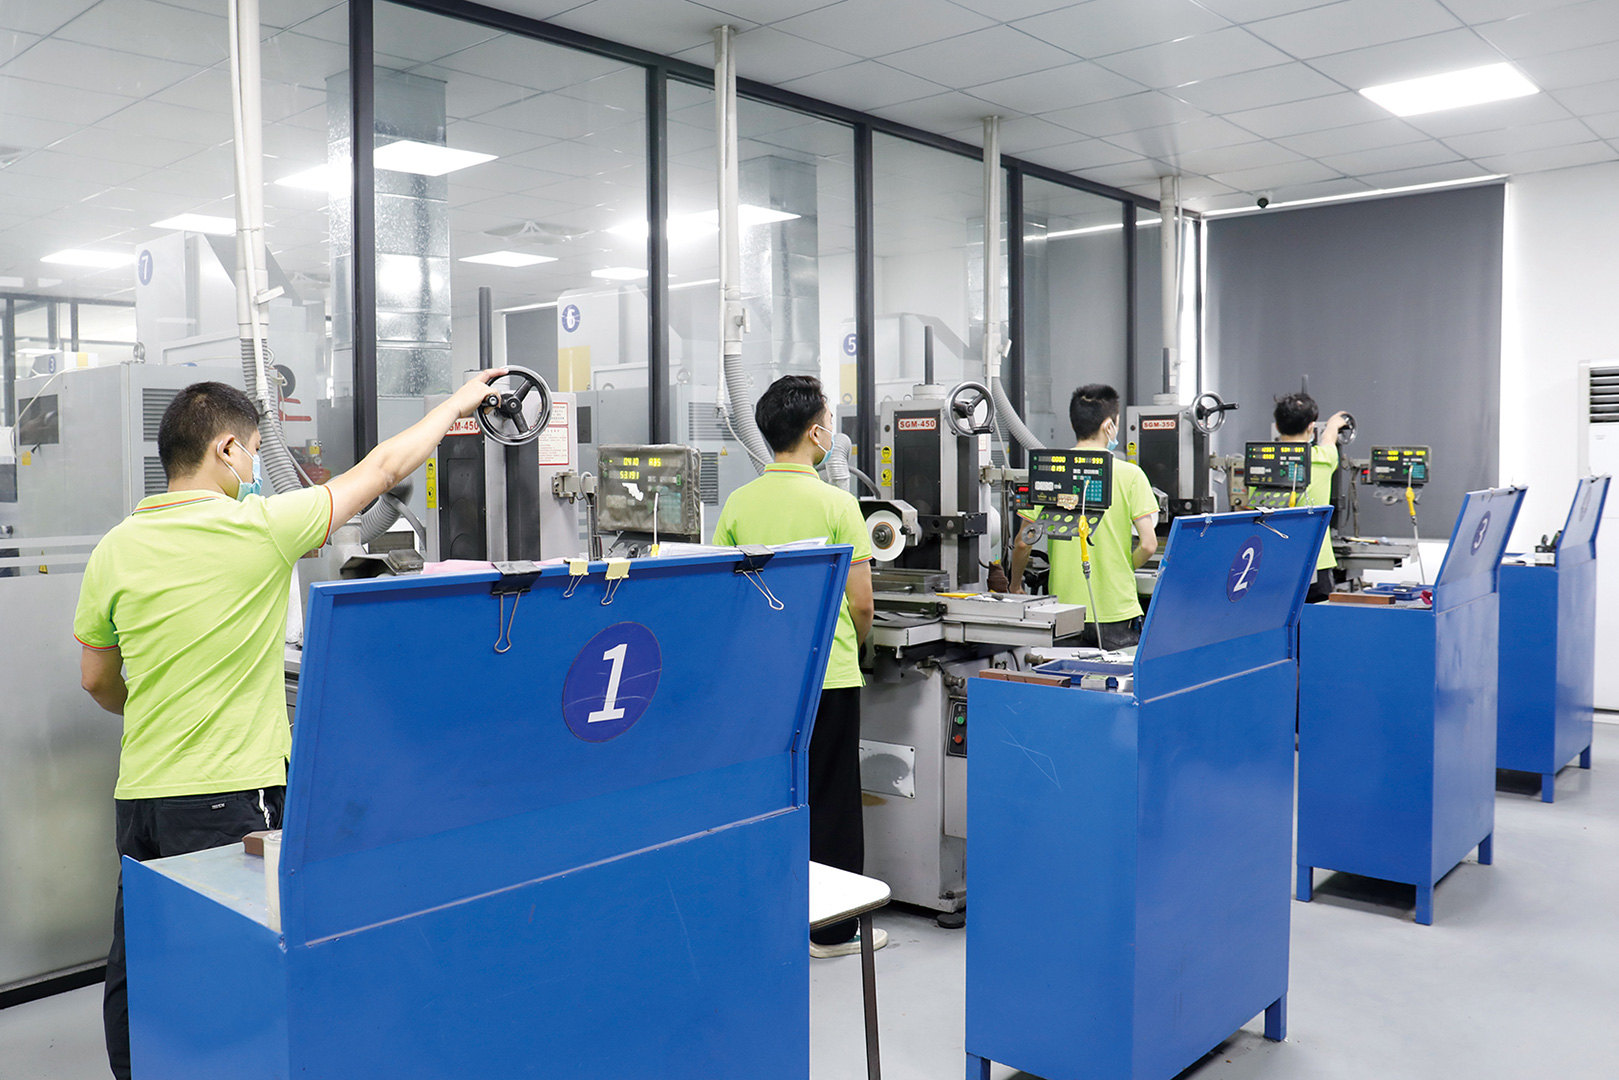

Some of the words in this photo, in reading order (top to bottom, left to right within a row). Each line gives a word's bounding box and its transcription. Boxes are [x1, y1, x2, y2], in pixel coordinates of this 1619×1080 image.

[141, 254, 149, 280] 7
[566, 308, 576, 329] 6
[847, 336, 857, 353] 5
[449, 420, 479, 432] GM-450
[900, 420, 936, 429] SGM-450
[1143, 421, 1176, 429] SGM-350
[1473, 518, 1488, 549] 3
[1232, 547, 1255, 593] 2
[587, 643, 628, 723] 1
